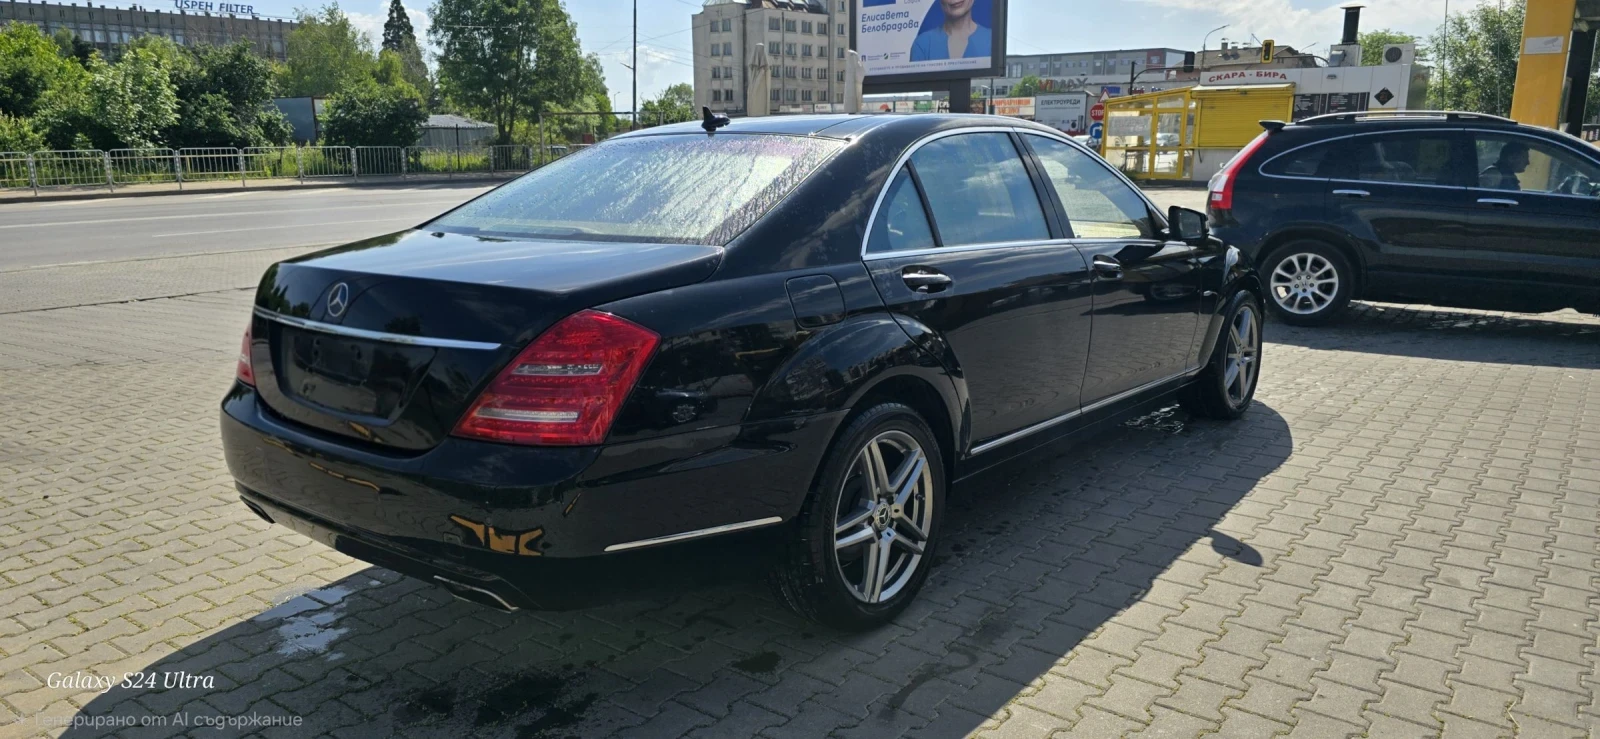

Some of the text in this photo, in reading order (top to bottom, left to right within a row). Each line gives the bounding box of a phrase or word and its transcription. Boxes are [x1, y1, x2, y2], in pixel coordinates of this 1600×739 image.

[175, 0, 254, 14] USPEH FILTER
[861, 11, 909, 22] Елисавета
[861, 20, 919, 33] Белобрадова
[1208, 71, 1246, 83] СКАРА
[1255, 70, 1287, 80] БИРА
